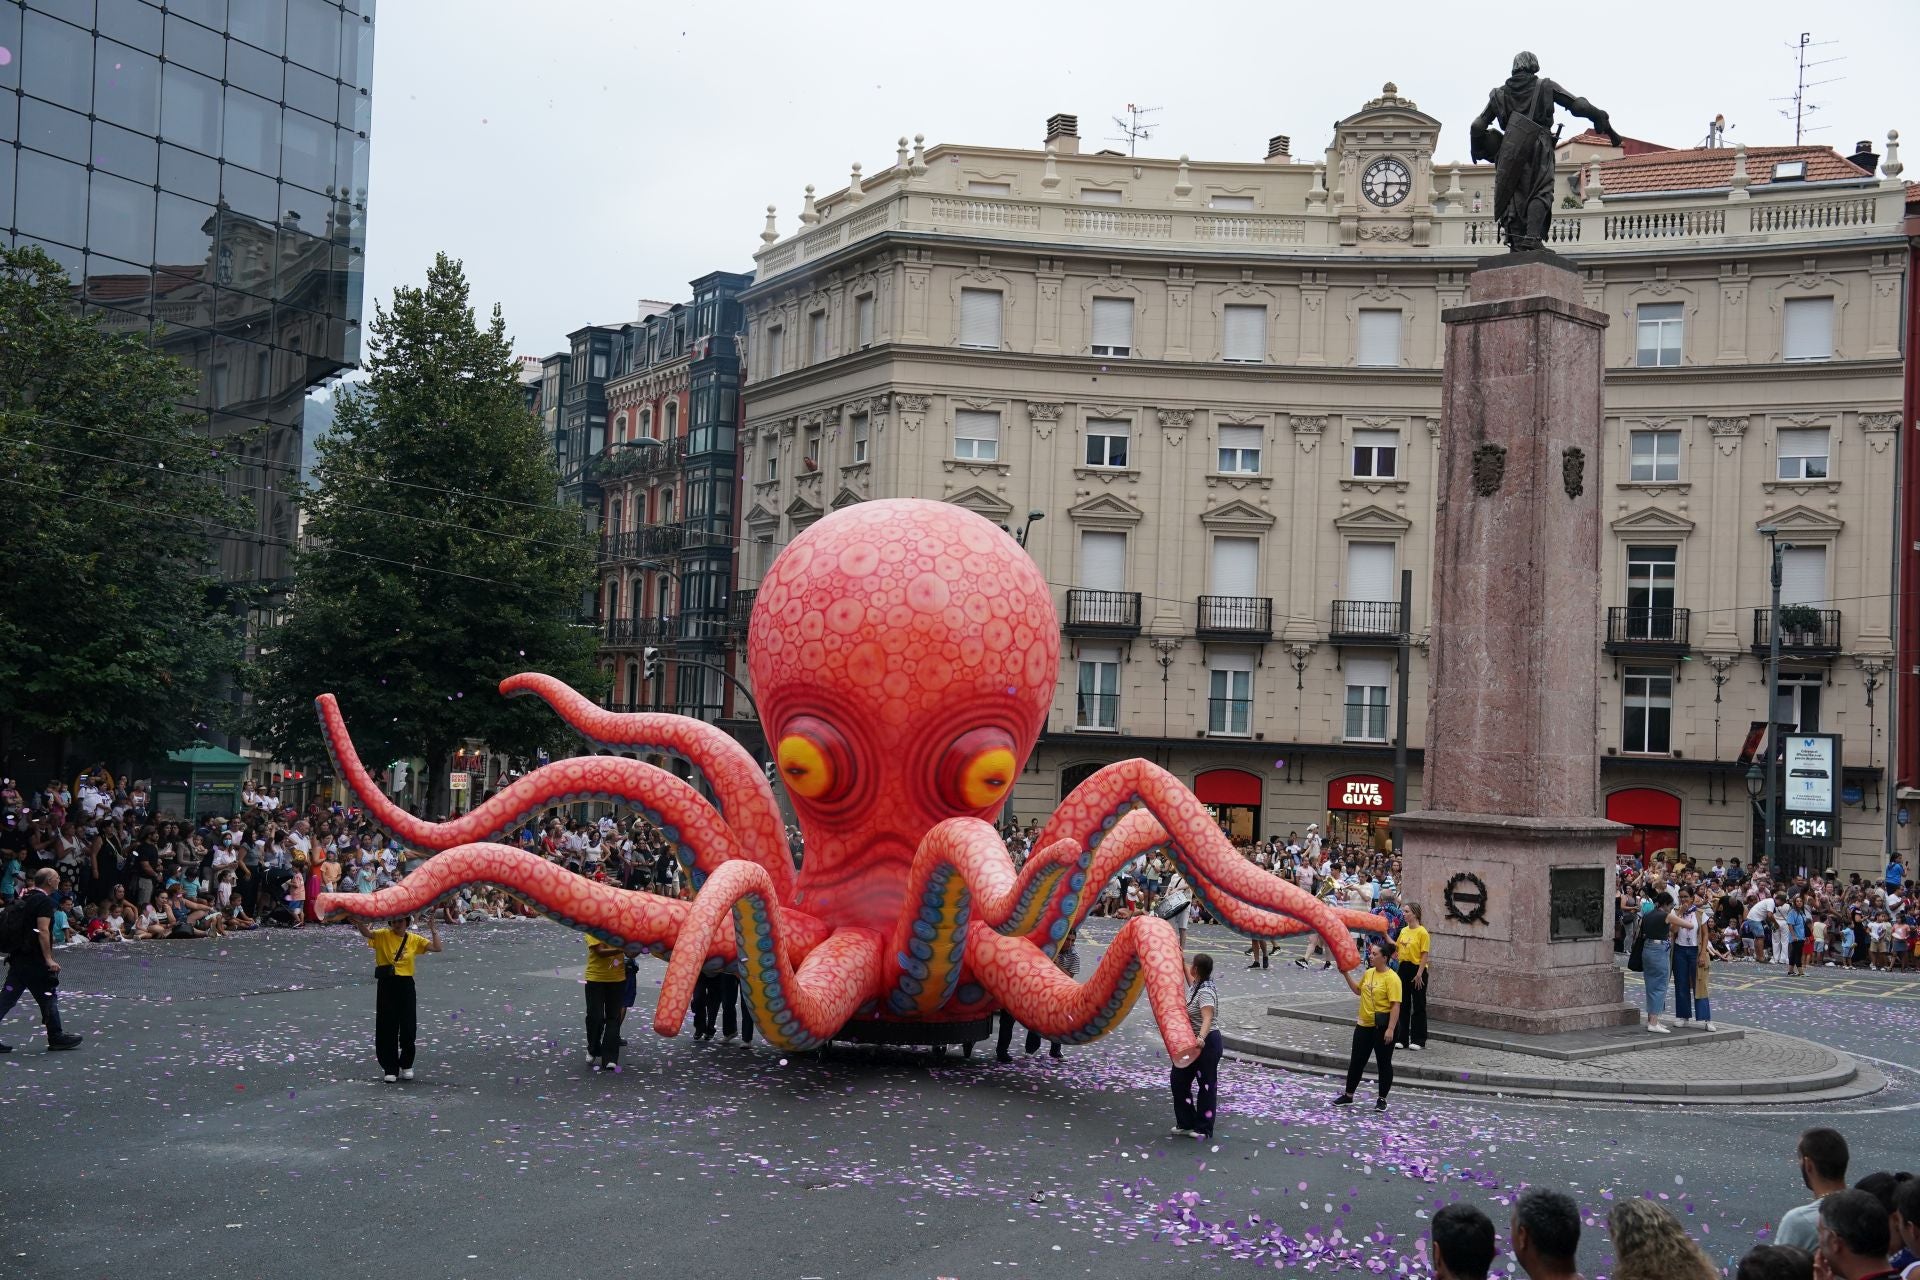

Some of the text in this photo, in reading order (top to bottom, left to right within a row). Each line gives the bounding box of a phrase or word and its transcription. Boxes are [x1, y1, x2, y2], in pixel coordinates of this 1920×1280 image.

[1346, 782, 1379, 794] FIVE
[1342, 793, 1383, 806] GUYS
[1789, 818, 1827, 837] 18:14
